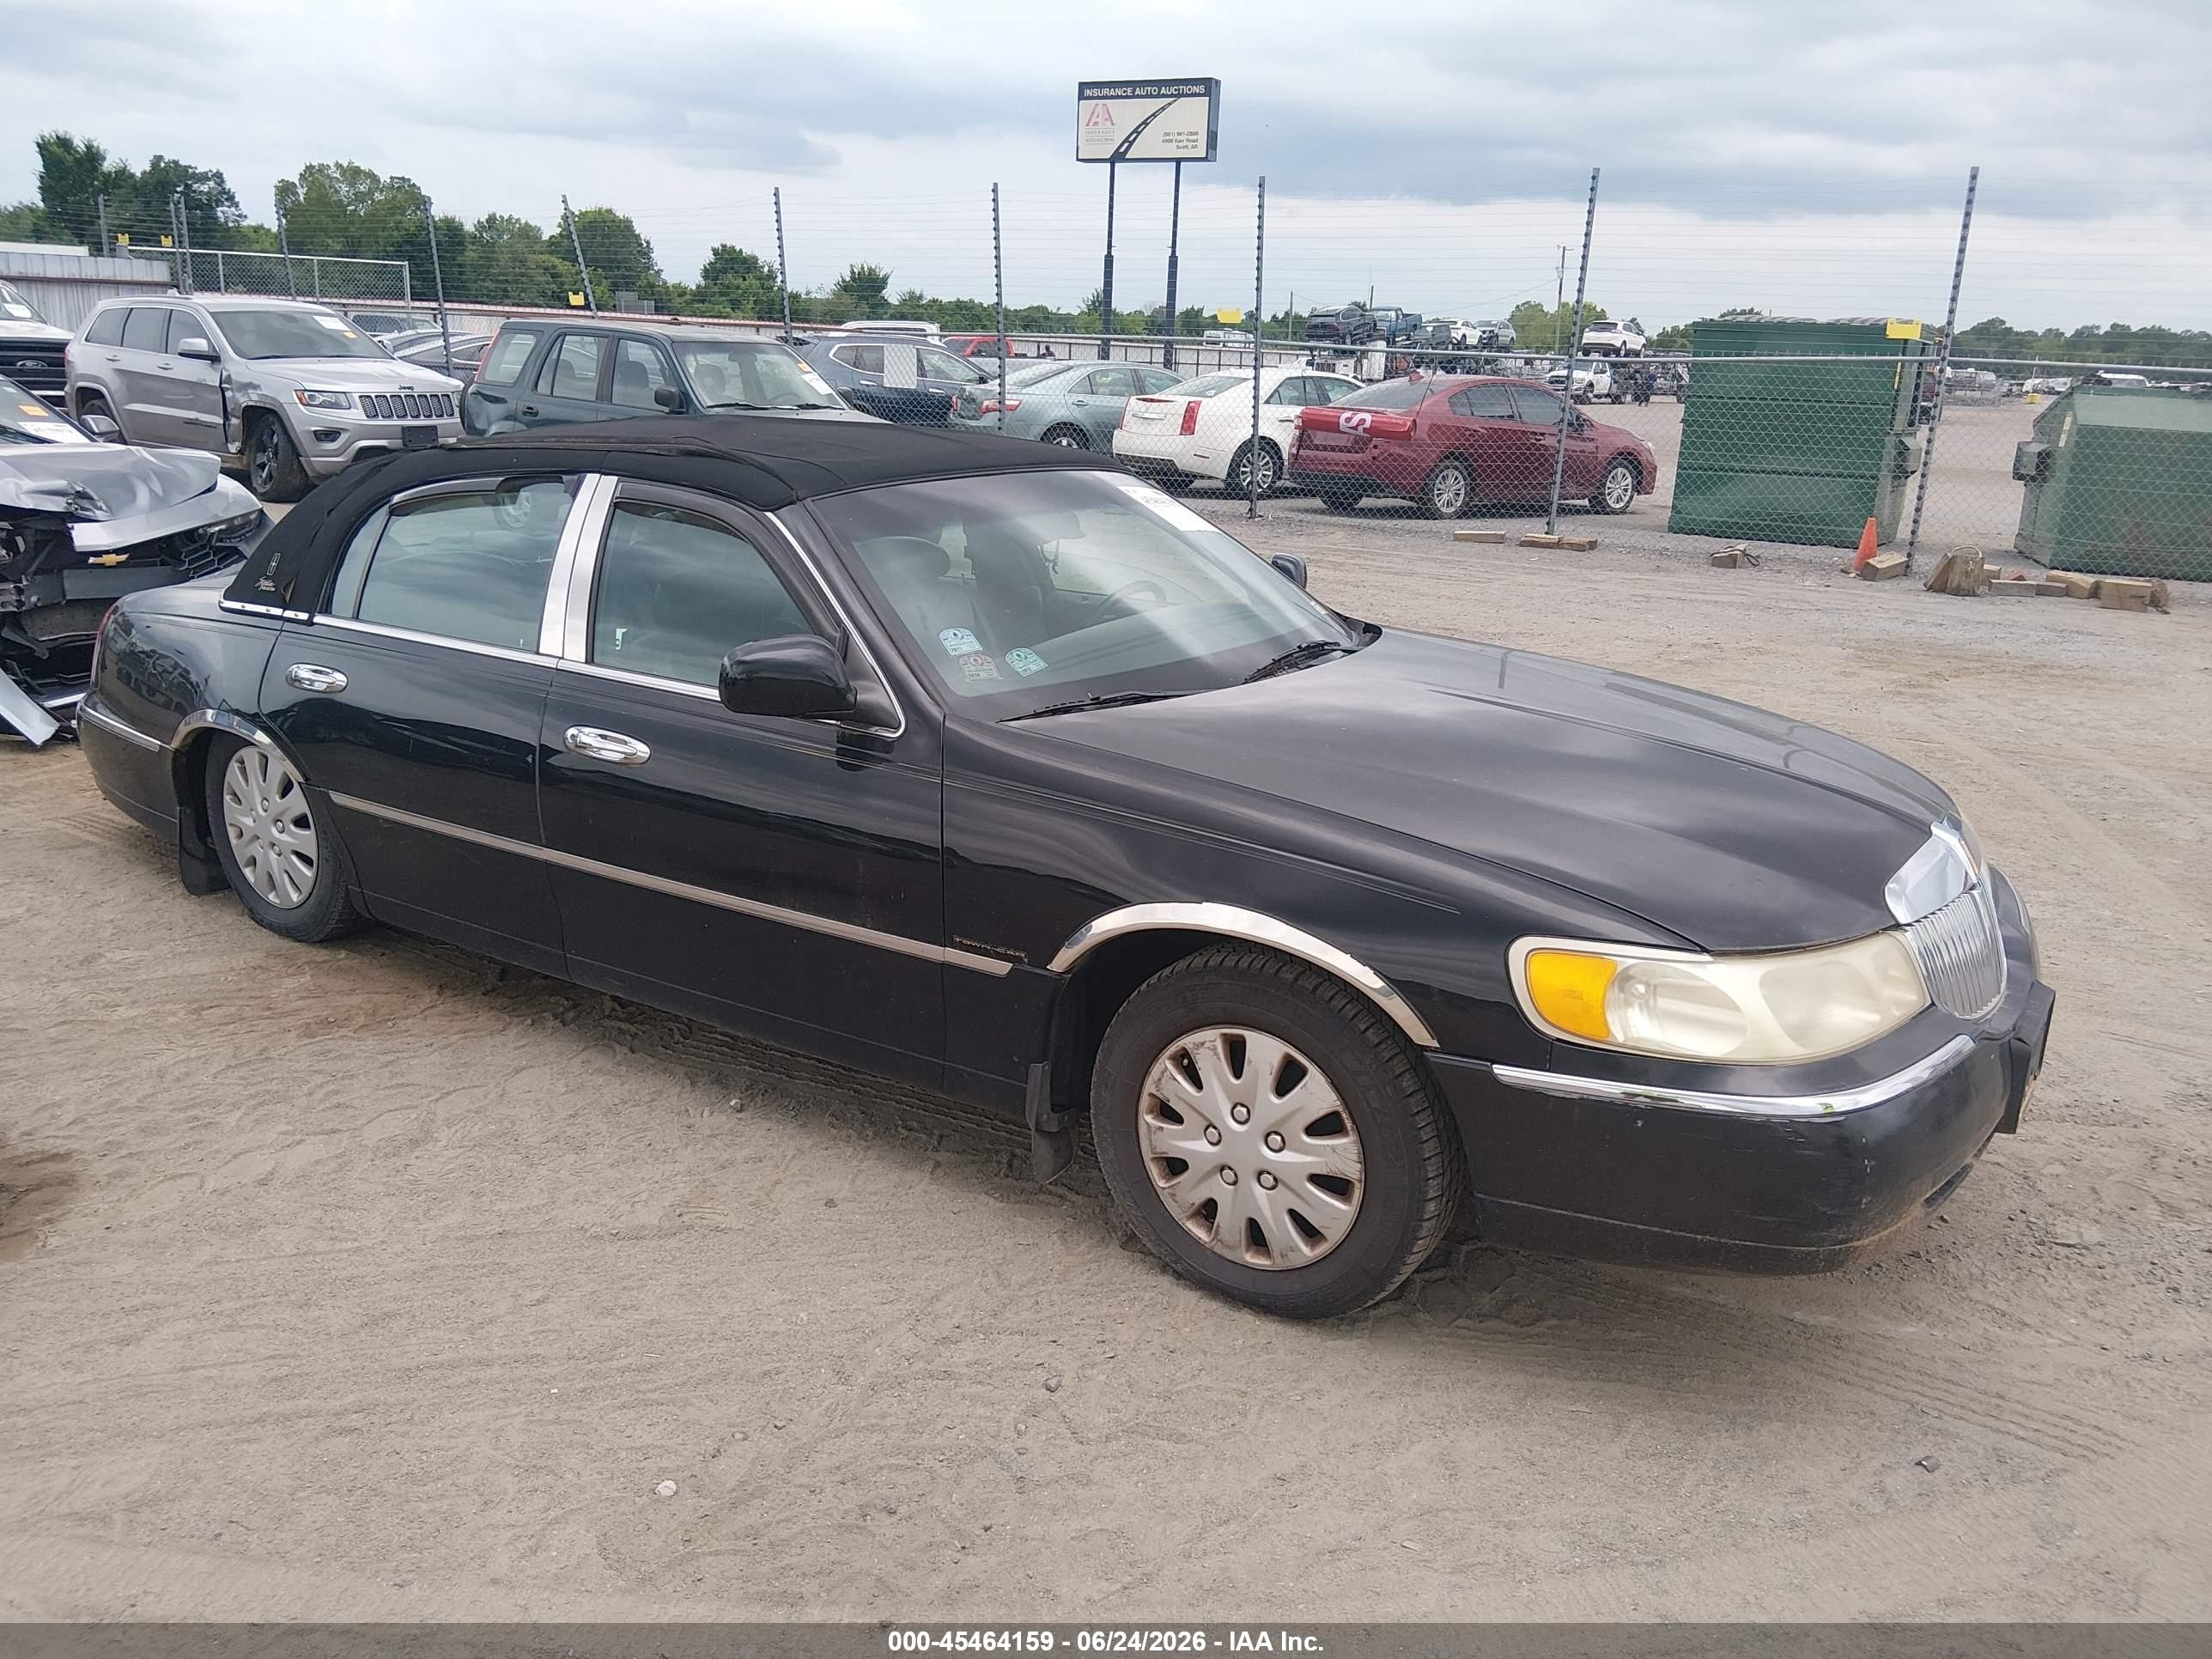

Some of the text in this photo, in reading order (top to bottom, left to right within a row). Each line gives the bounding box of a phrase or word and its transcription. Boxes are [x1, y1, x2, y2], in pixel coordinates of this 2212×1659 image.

[1084, 84, 1206, 97] INSURANCE AUTO AUCTIONS
